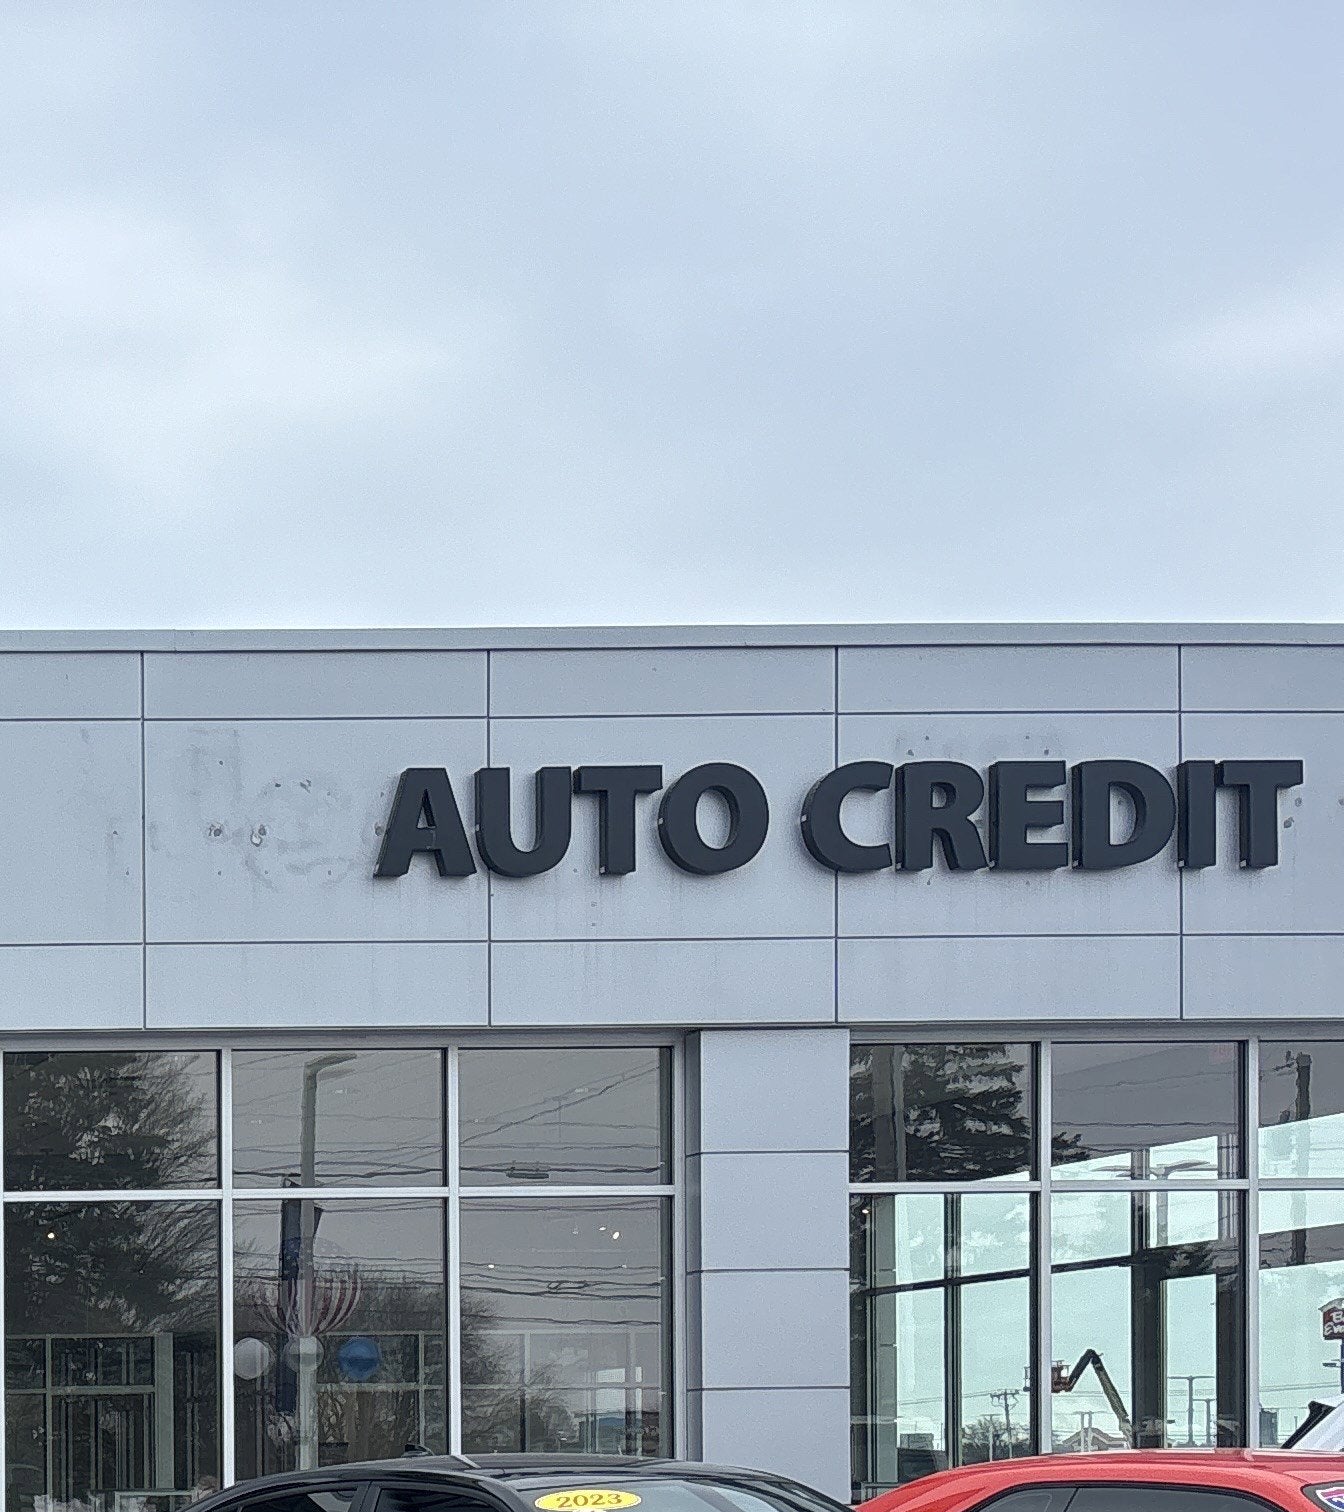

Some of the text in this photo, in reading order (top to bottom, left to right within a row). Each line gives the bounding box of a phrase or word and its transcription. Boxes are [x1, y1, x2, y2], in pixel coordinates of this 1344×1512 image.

[373, 760, 1304, 879] AUTO CREDIT
[555, 1492, 623, 1509] 2023
